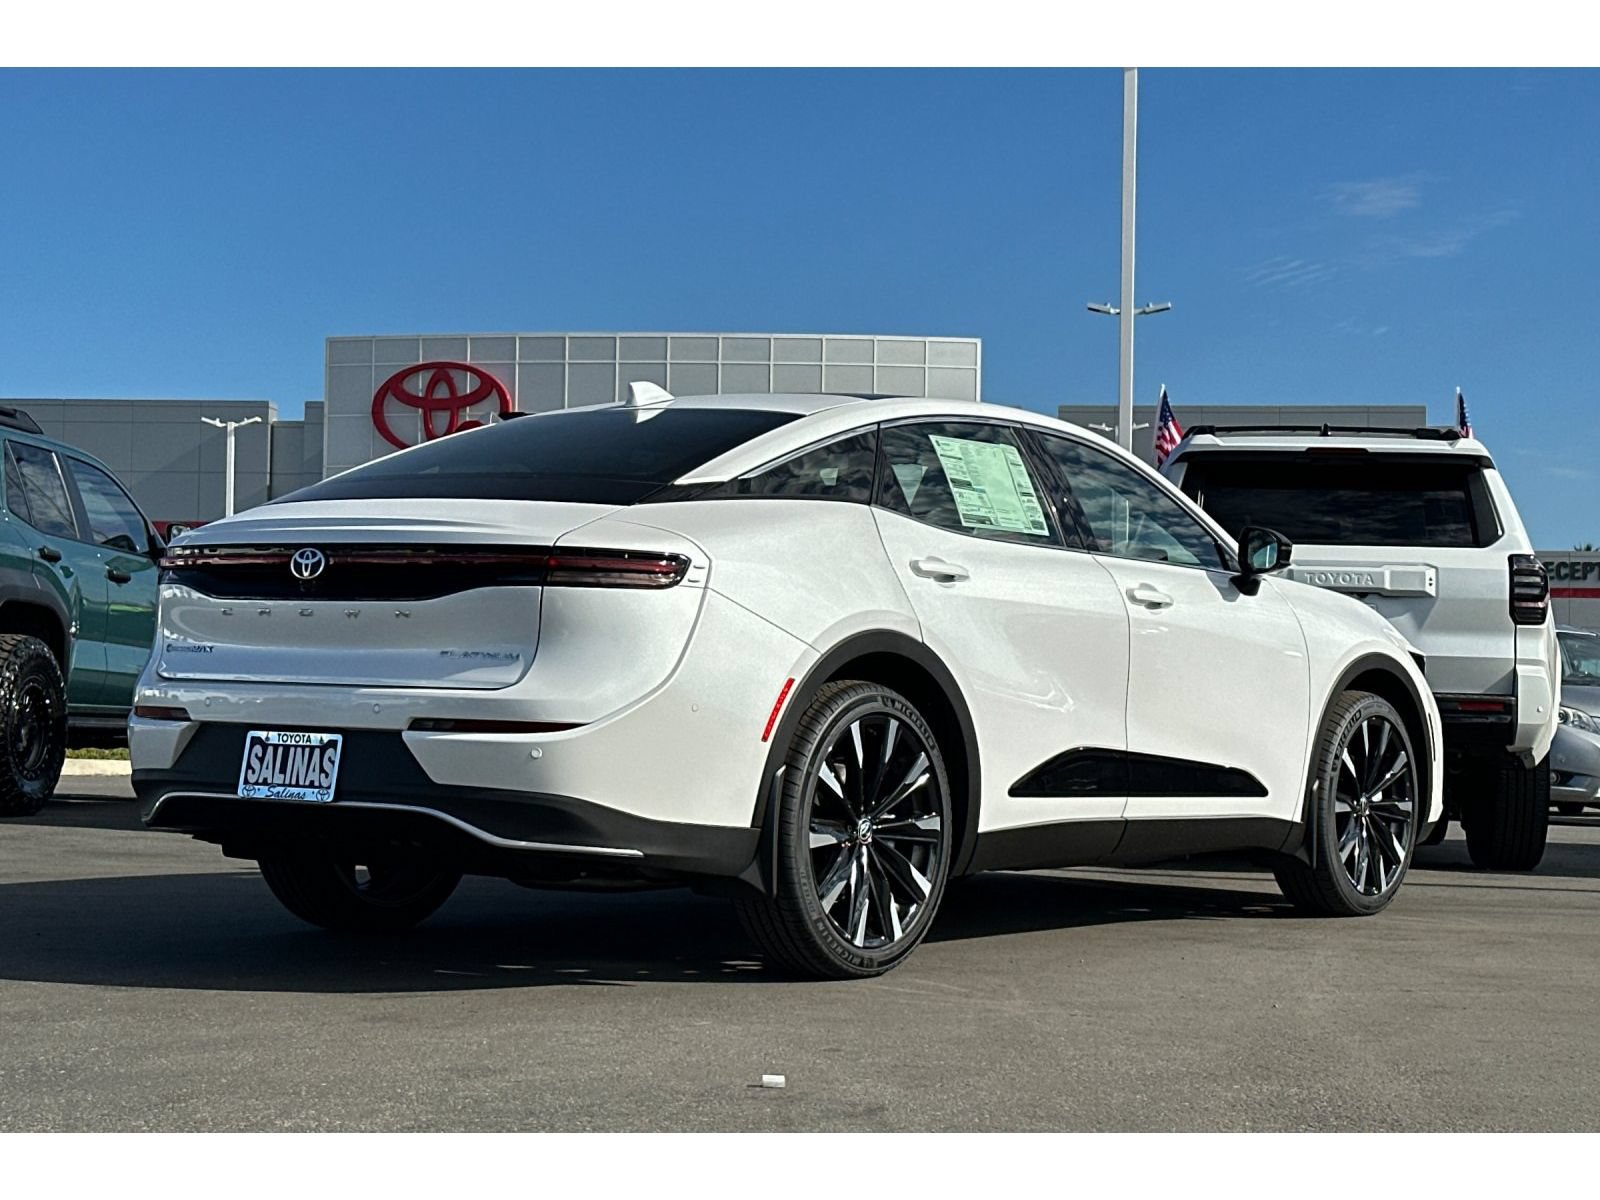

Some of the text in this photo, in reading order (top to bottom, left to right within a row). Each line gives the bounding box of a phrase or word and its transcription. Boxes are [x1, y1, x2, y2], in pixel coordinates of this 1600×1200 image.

[1304, 572, 1374, 585] TOYOTA
[220, 607, 411, 618] CROWN
[277, 733, 312, 744] TOYOTA
[247, 744, 336, 788] SALINAS
[265, 784, 306, 800] Salinas
